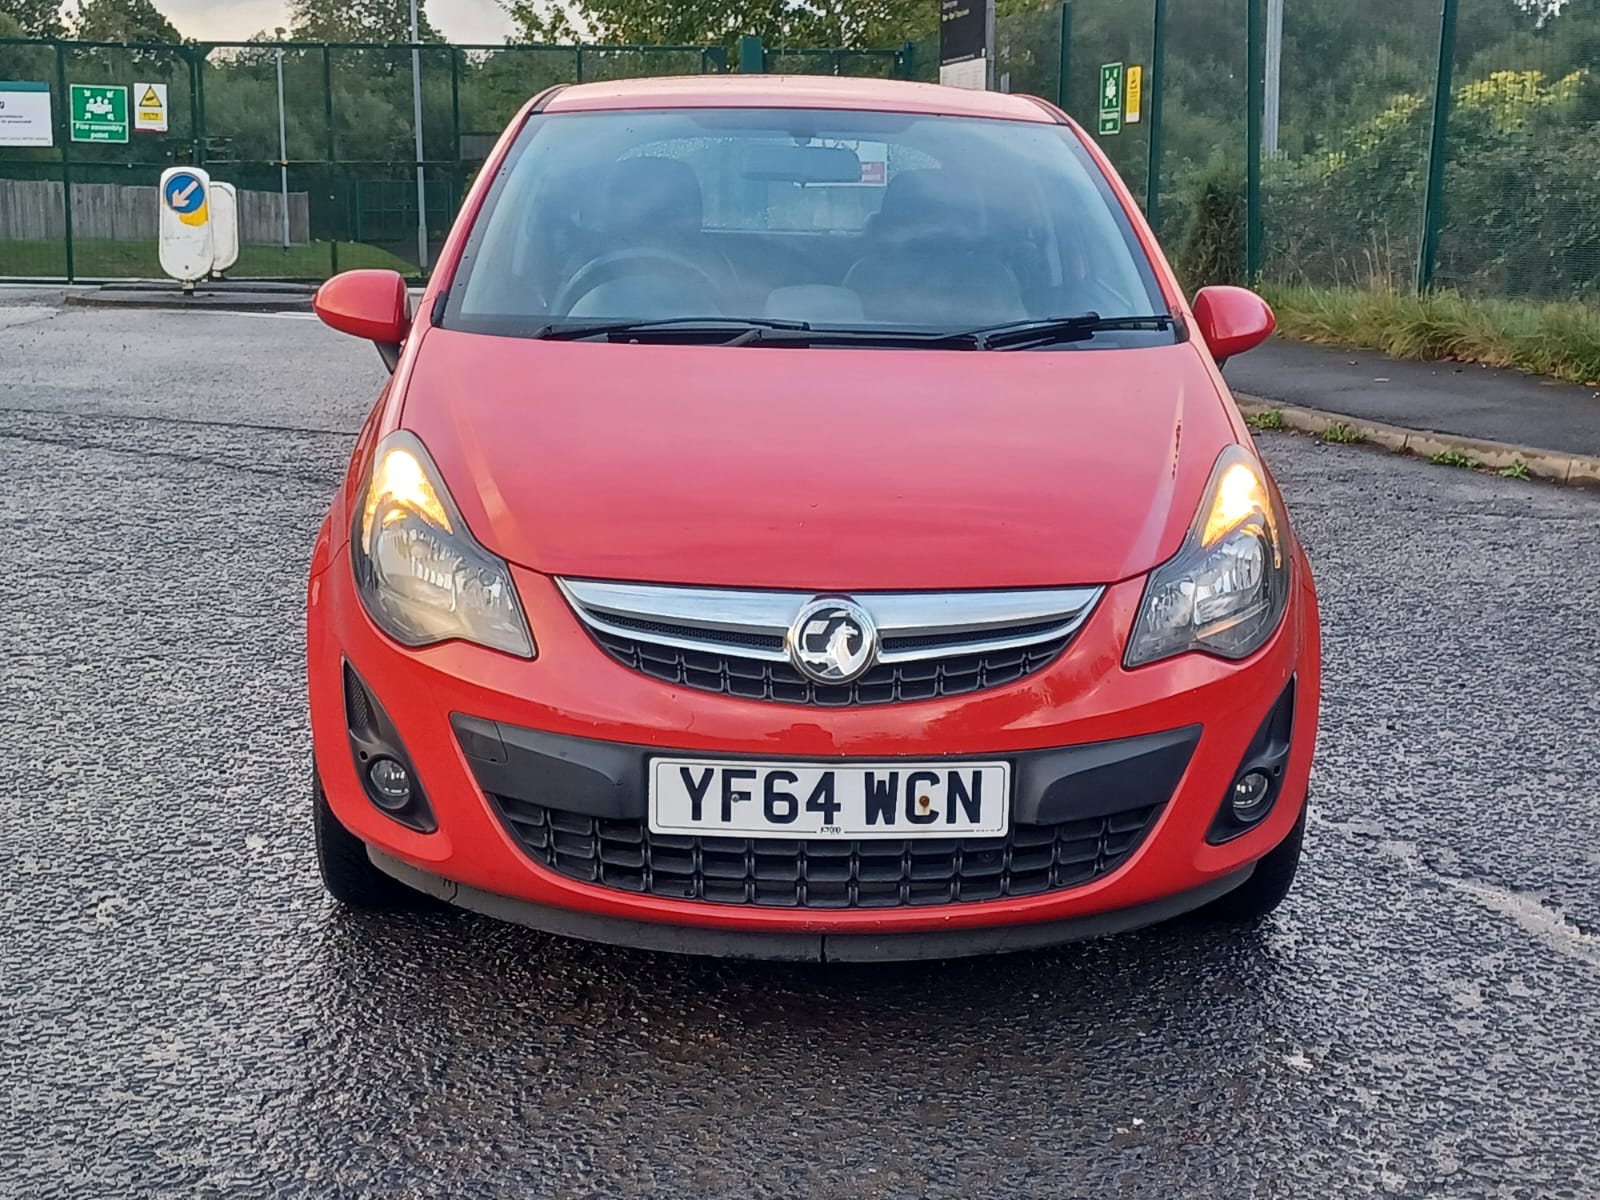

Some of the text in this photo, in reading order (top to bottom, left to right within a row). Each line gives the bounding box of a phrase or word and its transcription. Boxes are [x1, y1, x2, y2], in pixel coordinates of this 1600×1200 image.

[75, 123, 123, 133] Fire assembly
[90, 132, 109, 140] point
[679, 767, 983, 826] YF64 WCN
